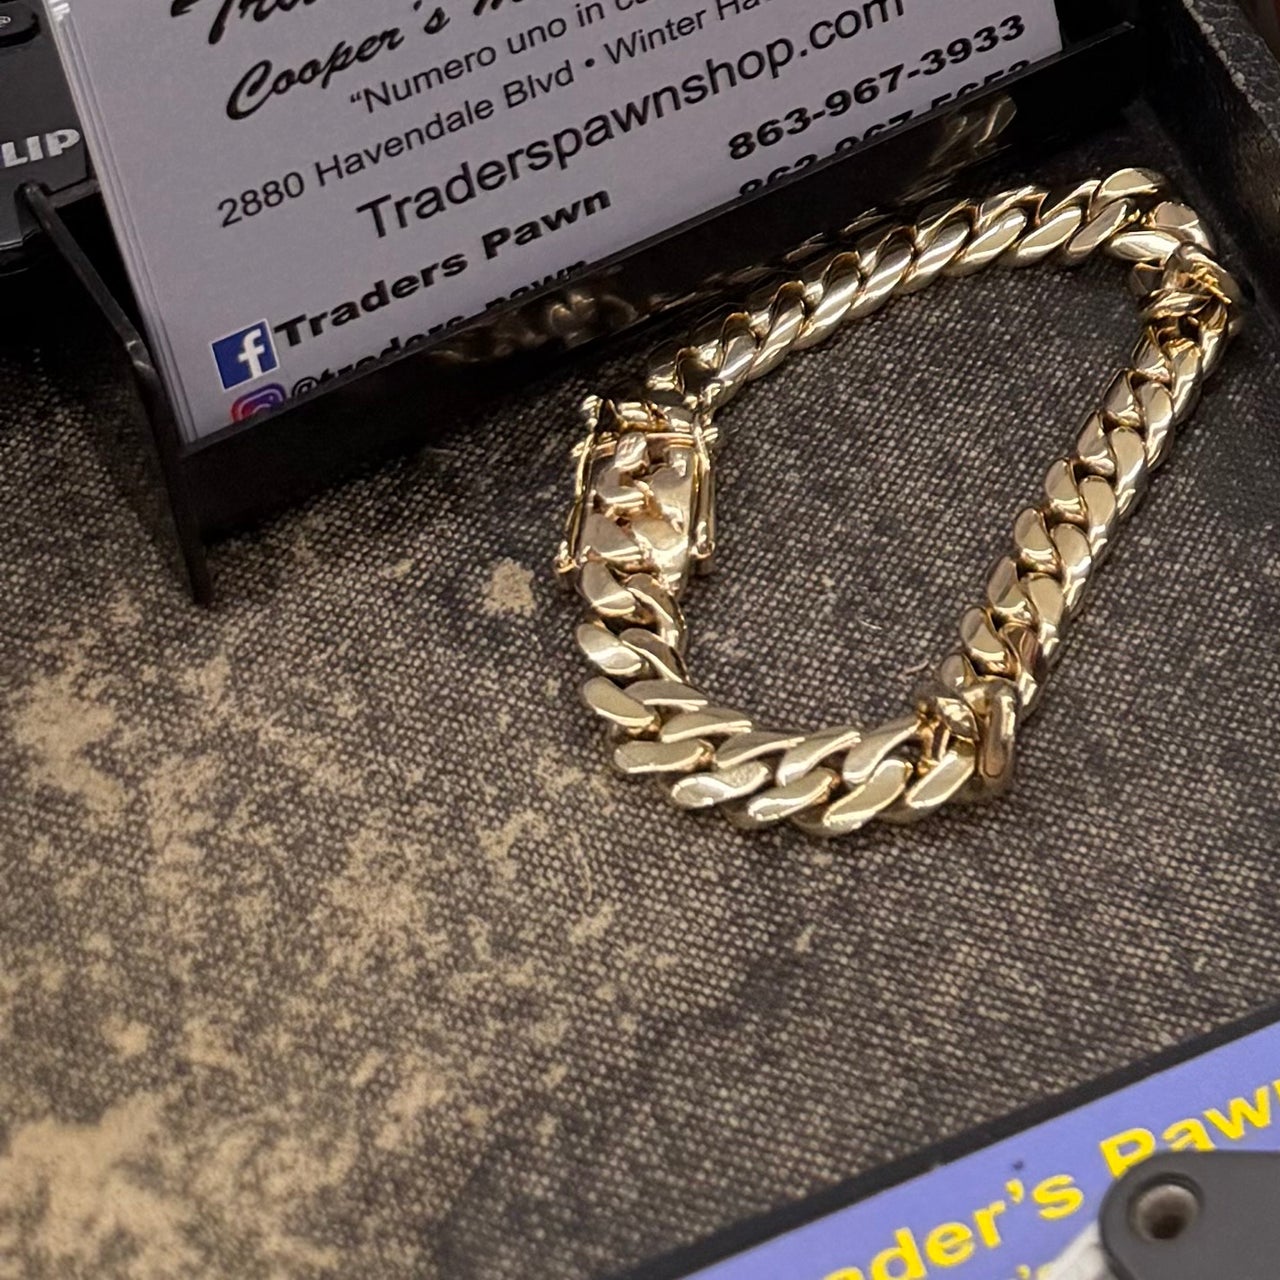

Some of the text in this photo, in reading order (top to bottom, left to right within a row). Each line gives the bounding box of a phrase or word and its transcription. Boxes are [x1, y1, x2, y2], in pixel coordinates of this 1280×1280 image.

[506, 16, 567, 56] uno
[575, 2, 606, 28] in
[728, 14, 1026, 162] 863-967-3933
[217, 171, 305, 227] 2880
[314, 96, 494, 188] Havendale
[503, 59, 576, 110] Blvd
[603, 5, 706, 67] Winter
[274, 249, 469, 348] Traders
[481, 189, 613, 260] Pawn
